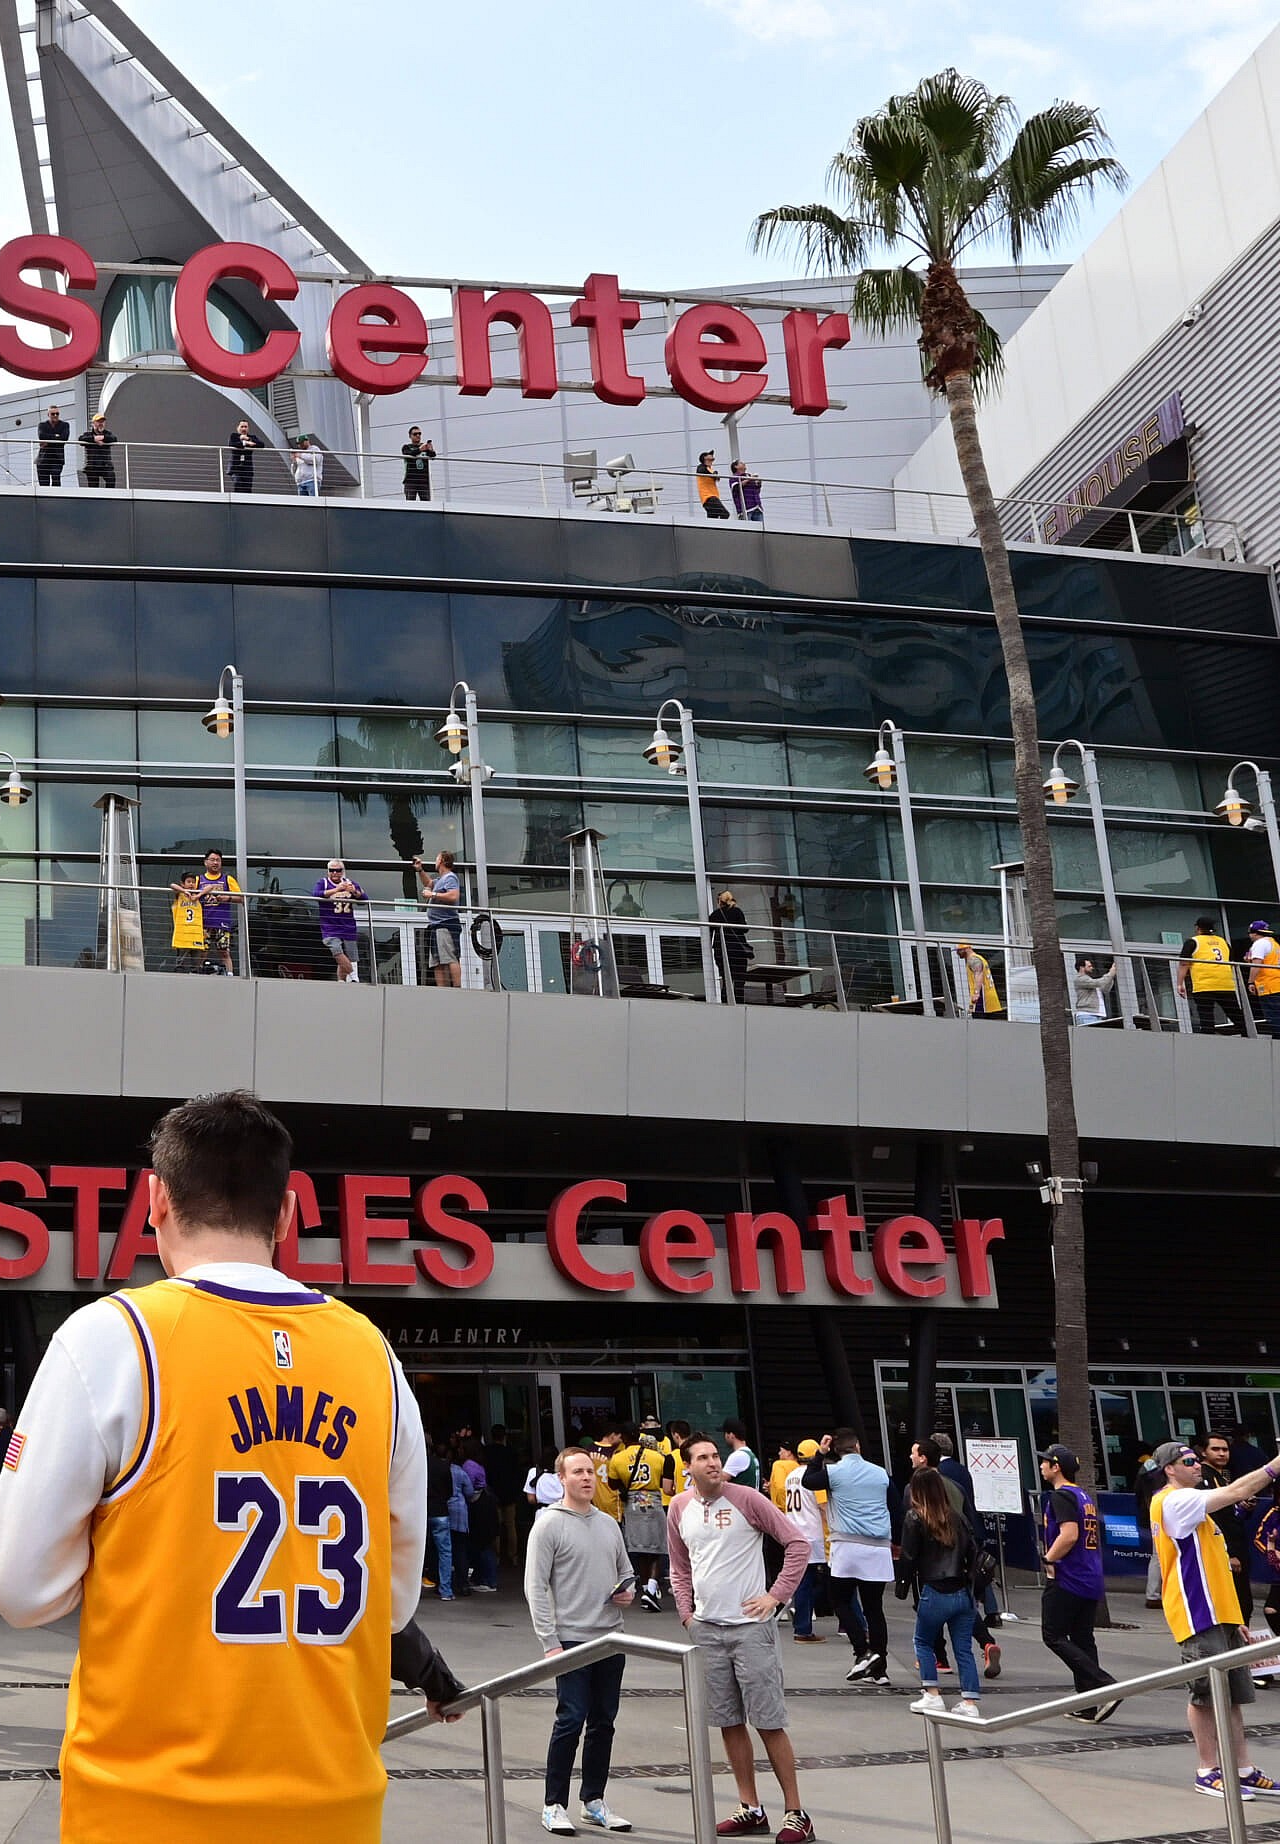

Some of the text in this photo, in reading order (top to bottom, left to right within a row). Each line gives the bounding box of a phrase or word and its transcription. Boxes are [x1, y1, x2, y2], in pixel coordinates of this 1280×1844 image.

[174, 242, 850, 416] Center
[1065, 416, 1164, 528] HOUSE
[186, 908, 194, 922] 3
[1212, 948, 1223, 962] 3
[546, 1179, 1005, 1299] Center
[387, 1328, 522, 1344] LAZA ENTRY
[963, 1370, 974, 1382] 2
[1107, 1373, 1116, 1384] 4
[1178, 1374, 1186, 1385] 5
[1245, 1375, 1253, 1386] 6
[227, 1384, 357, 1460] JAMES
[786, 1489, 802, 1512] 20
[211, 1470, 369, 1645] 23
